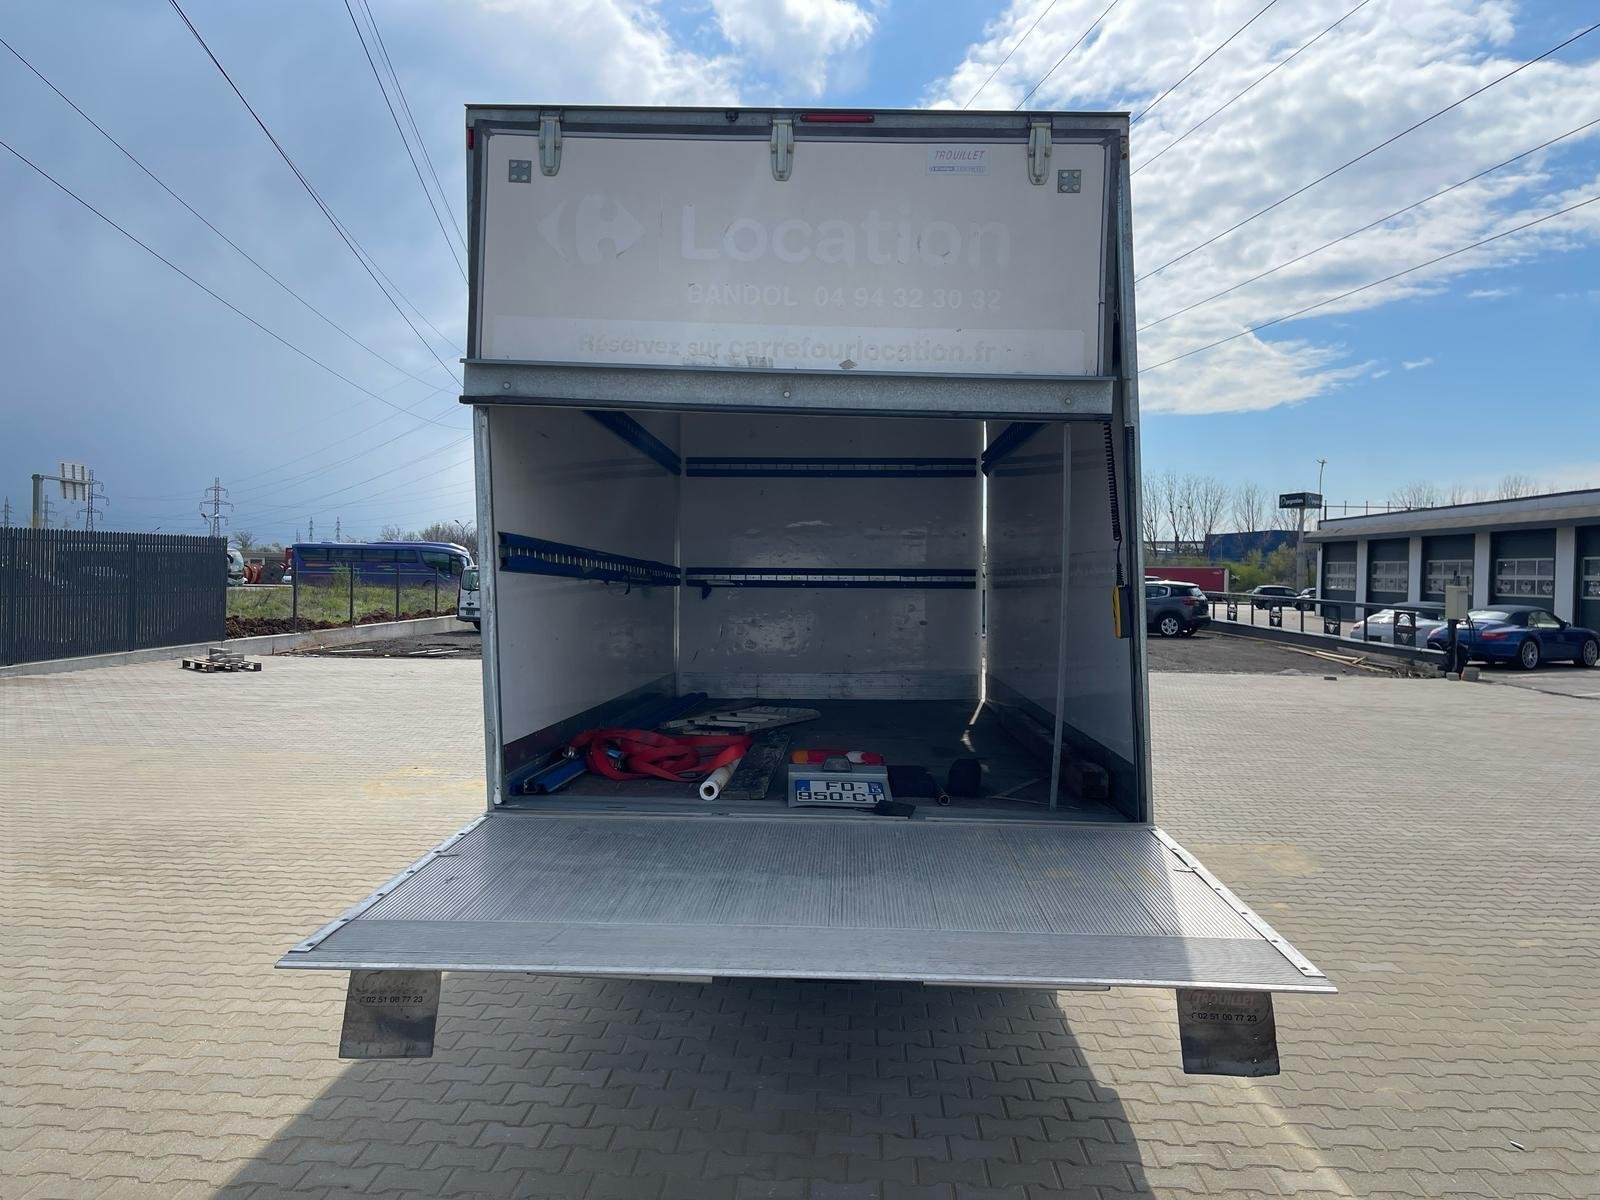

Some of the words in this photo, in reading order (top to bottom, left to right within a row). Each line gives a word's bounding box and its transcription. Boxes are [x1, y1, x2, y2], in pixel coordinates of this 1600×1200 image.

[935, 150, 986, 160] TROUILLET
[681, 204, 1011, 268] Location
[687, 283, 798, 308] BANDOL
[814, 286, 845, 308] 04
[854, 286, 885, 309] 94
[892, 287, 924, 309] 32
[933, 288, 963, 310] 30
[971, 289, 1002, 311] 32
[580, 332, 680, 356] Réservez
[688, 339, 724, 359] sur
[729, 336, 997, 364] carrefourlocation.fr
[366, 995, 376, 1003] 02
[378, 995, 388, 1003] 51
[413, 995, 424, 1003] 23
[1198, 1012, 1208, 1020] 02
[1210, 1012, 1220, 1020] 51
[1222, 1013, 1233, 1021] 00
[1235, 1014, 1245, 1022] 77
[1247, 1014, 1258, 1022] 23
